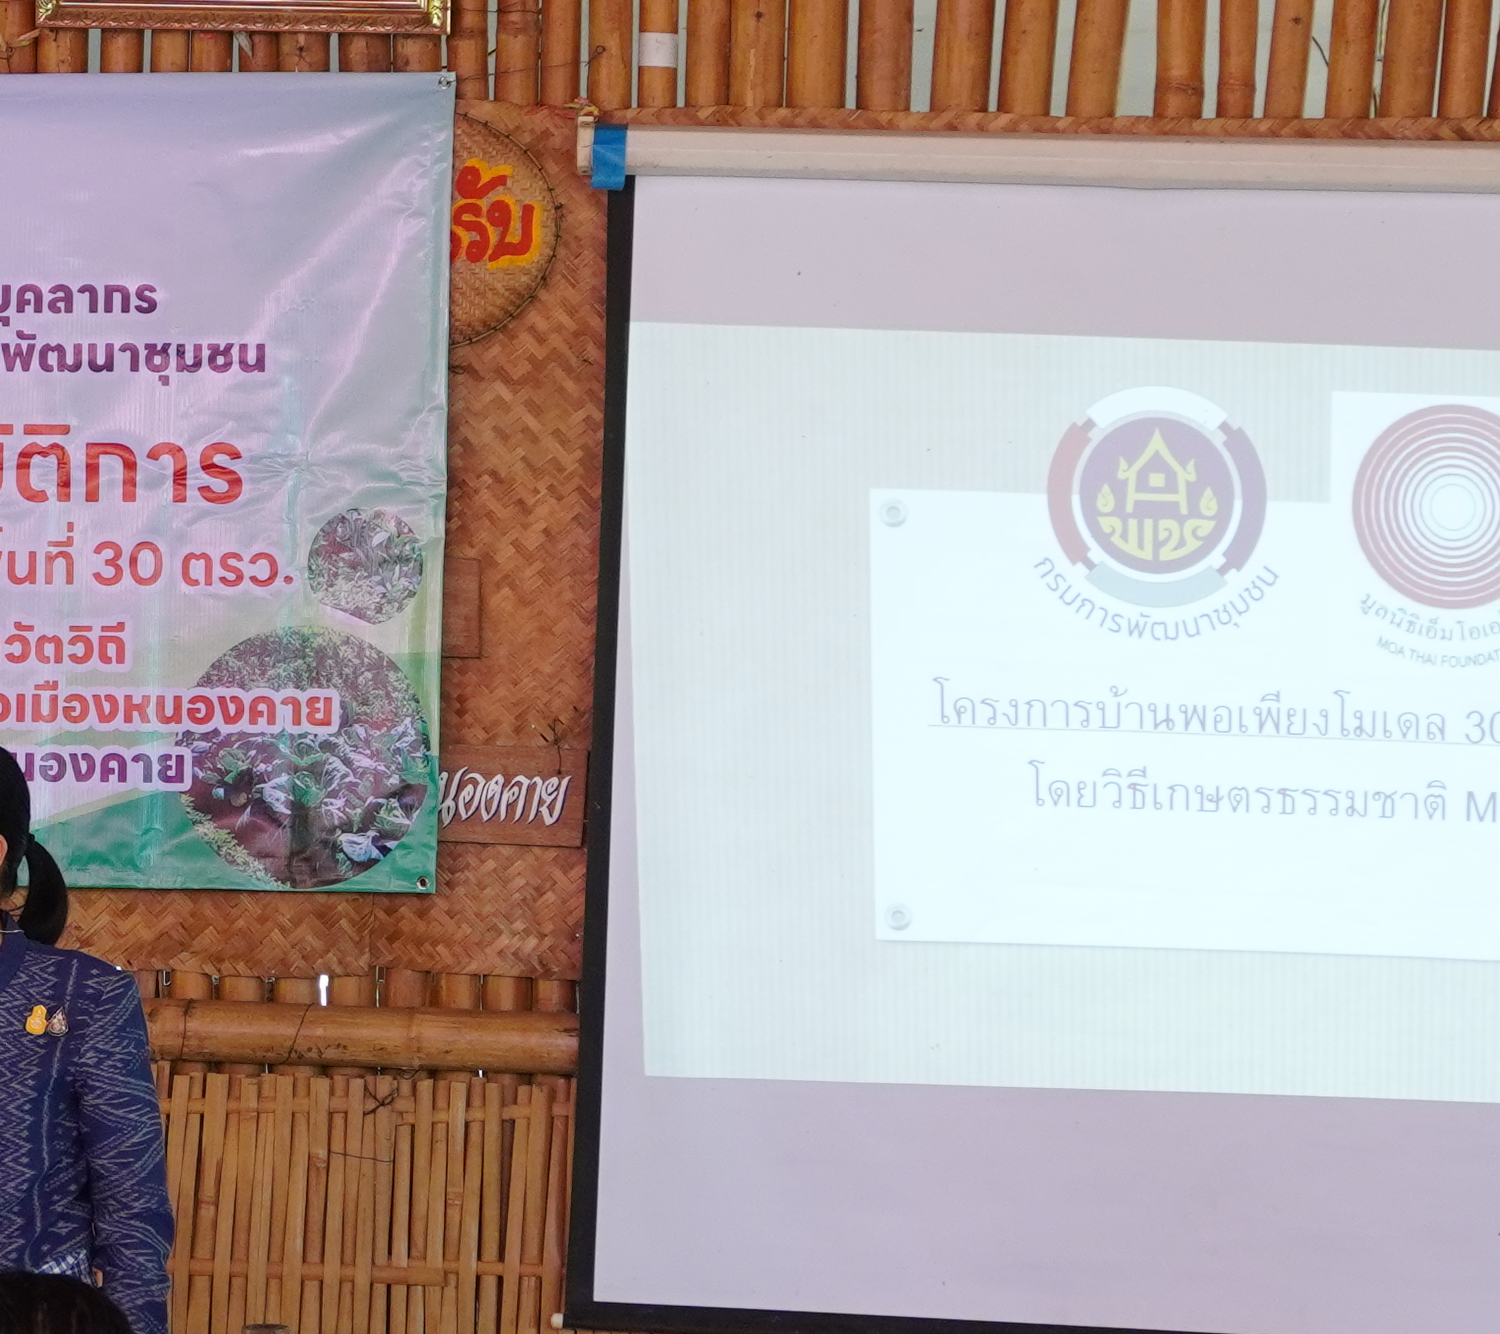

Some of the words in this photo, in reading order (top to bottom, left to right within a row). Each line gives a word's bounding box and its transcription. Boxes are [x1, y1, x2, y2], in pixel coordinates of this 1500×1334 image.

[92, 540, 164, 587] 30
[181, 550, 295, 588] ตรว.
[1033, 553, 1281, 642] กรมการพัฒนาชุมชน
[1377, 635, 1406, 658] MOA
[1409, 648, 1438, 666] THAI
[931, 676, 1448, 743] โครงการบ้านพอเพียงโมเดล
[1028, 758, 1447, 819] โดยวิธีเกษตรธรรมชาติ
